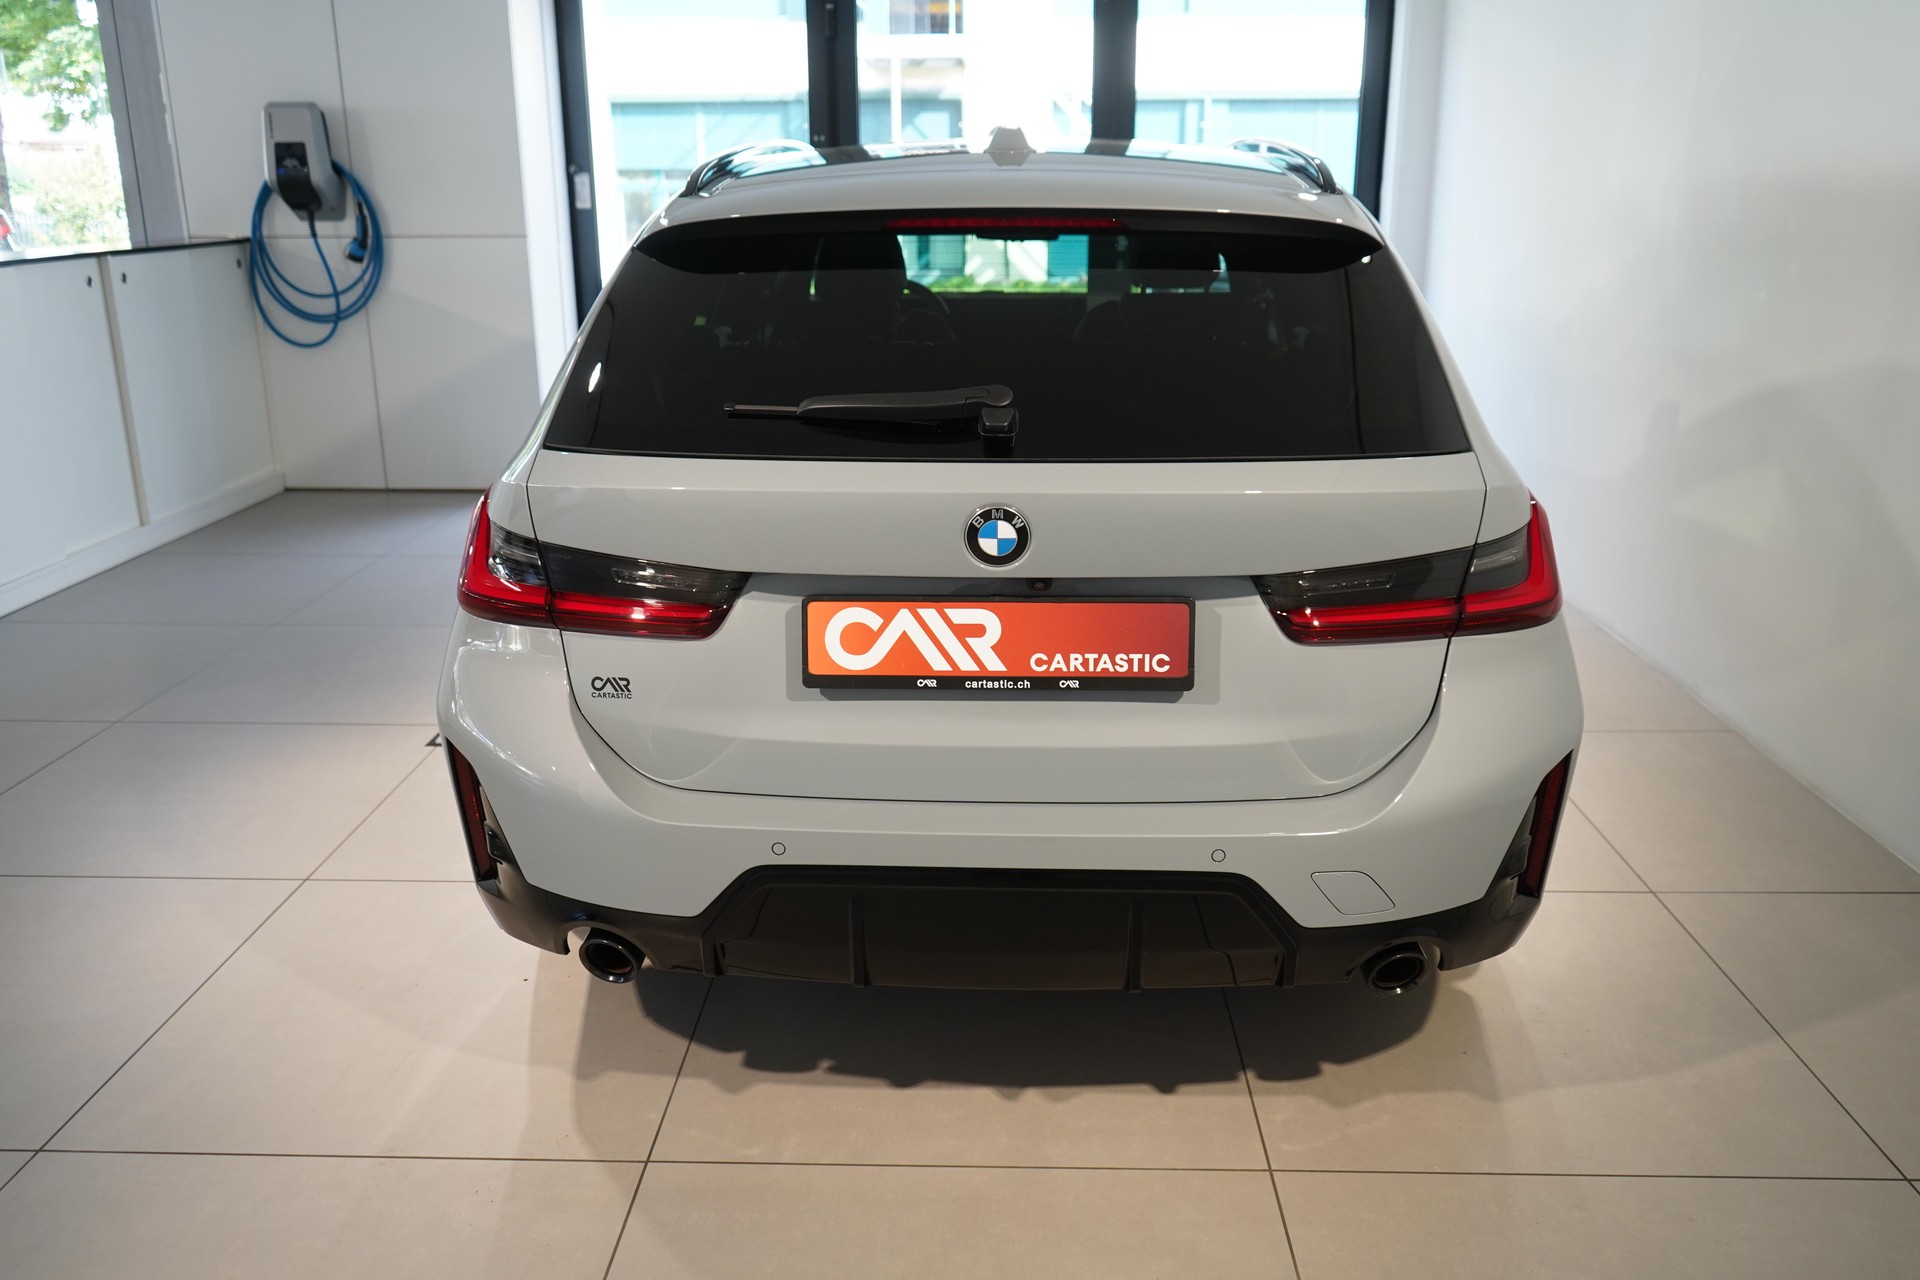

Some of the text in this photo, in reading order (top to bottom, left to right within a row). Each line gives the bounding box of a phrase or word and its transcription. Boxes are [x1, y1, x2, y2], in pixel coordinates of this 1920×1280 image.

[972, 509, 1024, 529] BMW
[1030, 653, 1171, 673] CARTASTIC
[965, 679, 1031, 689] cartastic.ch
